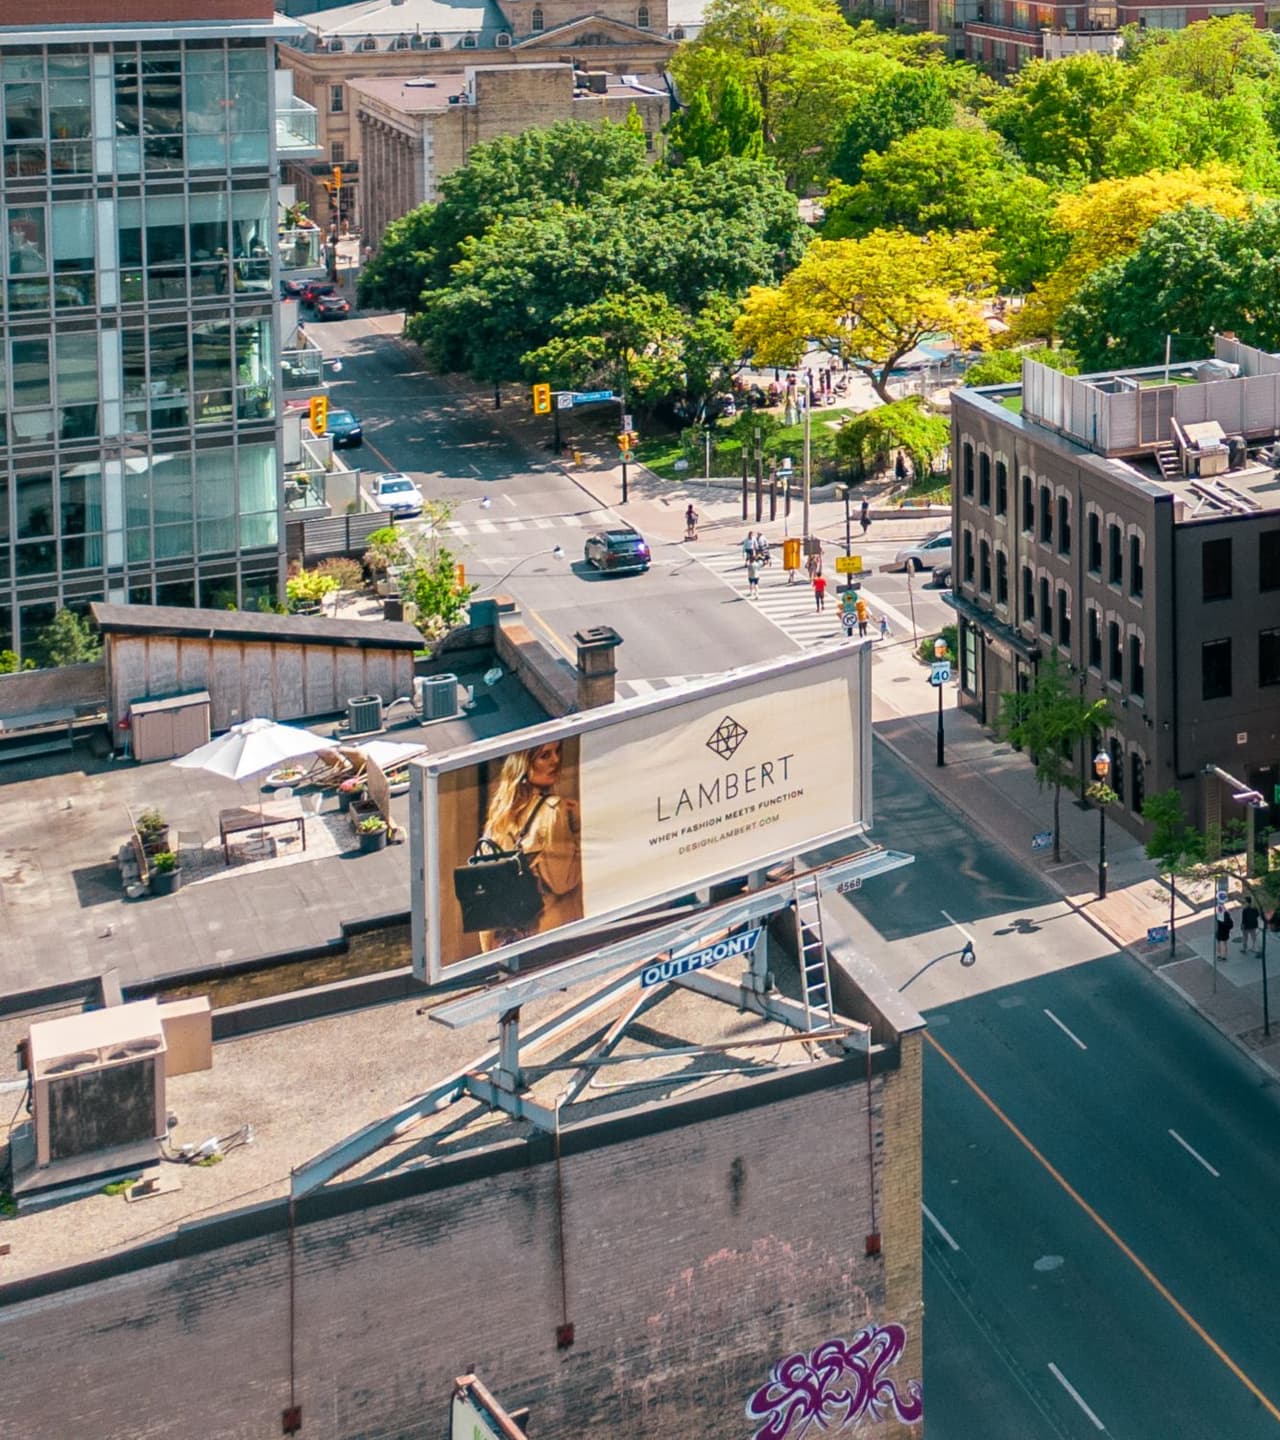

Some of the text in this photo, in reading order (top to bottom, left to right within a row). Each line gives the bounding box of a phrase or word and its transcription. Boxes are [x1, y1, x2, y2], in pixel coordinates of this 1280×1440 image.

[933, 670, 949, 681] 40
[656, 754, 794, 823] LAMBERT
[648, 788, 804, 847] WHEN FASHION MEETS FUNCTION
[678, 814, 780, 856] DESIGNLAMBERT.COM
[644, 932, 756, 986] OUTFRONT
